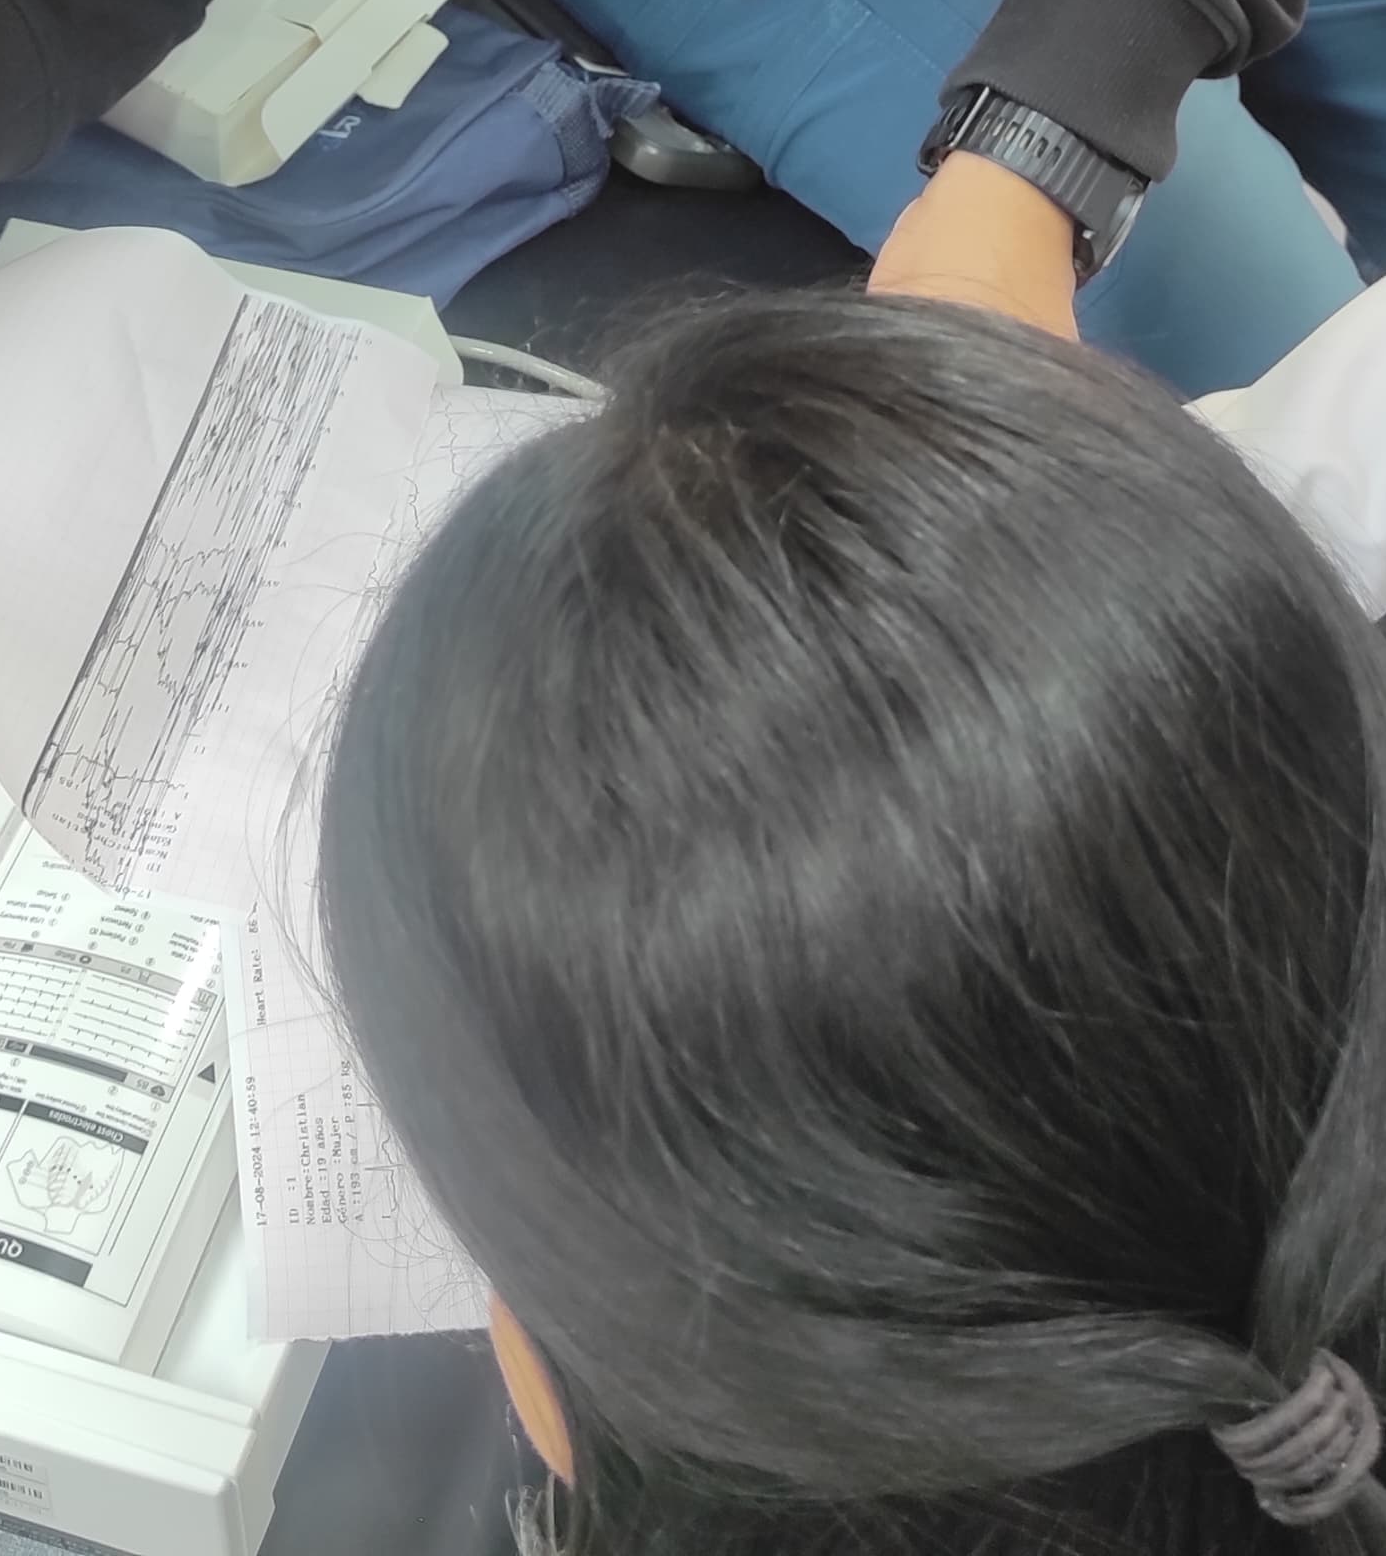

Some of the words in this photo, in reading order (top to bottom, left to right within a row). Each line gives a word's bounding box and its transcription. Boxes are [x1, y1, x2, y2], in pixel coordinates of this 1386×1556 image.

[255, 989, 267, 1026] Heart
[48, 1108, 96, 1132] electrodes
[245, 1076, 261, 1138] 12:40:59
[95, 1124, 124, 1143] Chest
[315, 1117, 326, 1150] años
[250, 1146, 268, 1226] 17-08-2024
[289, 1208, 300, 1224] ID
[319, 1190, 332, 1224] Edad
